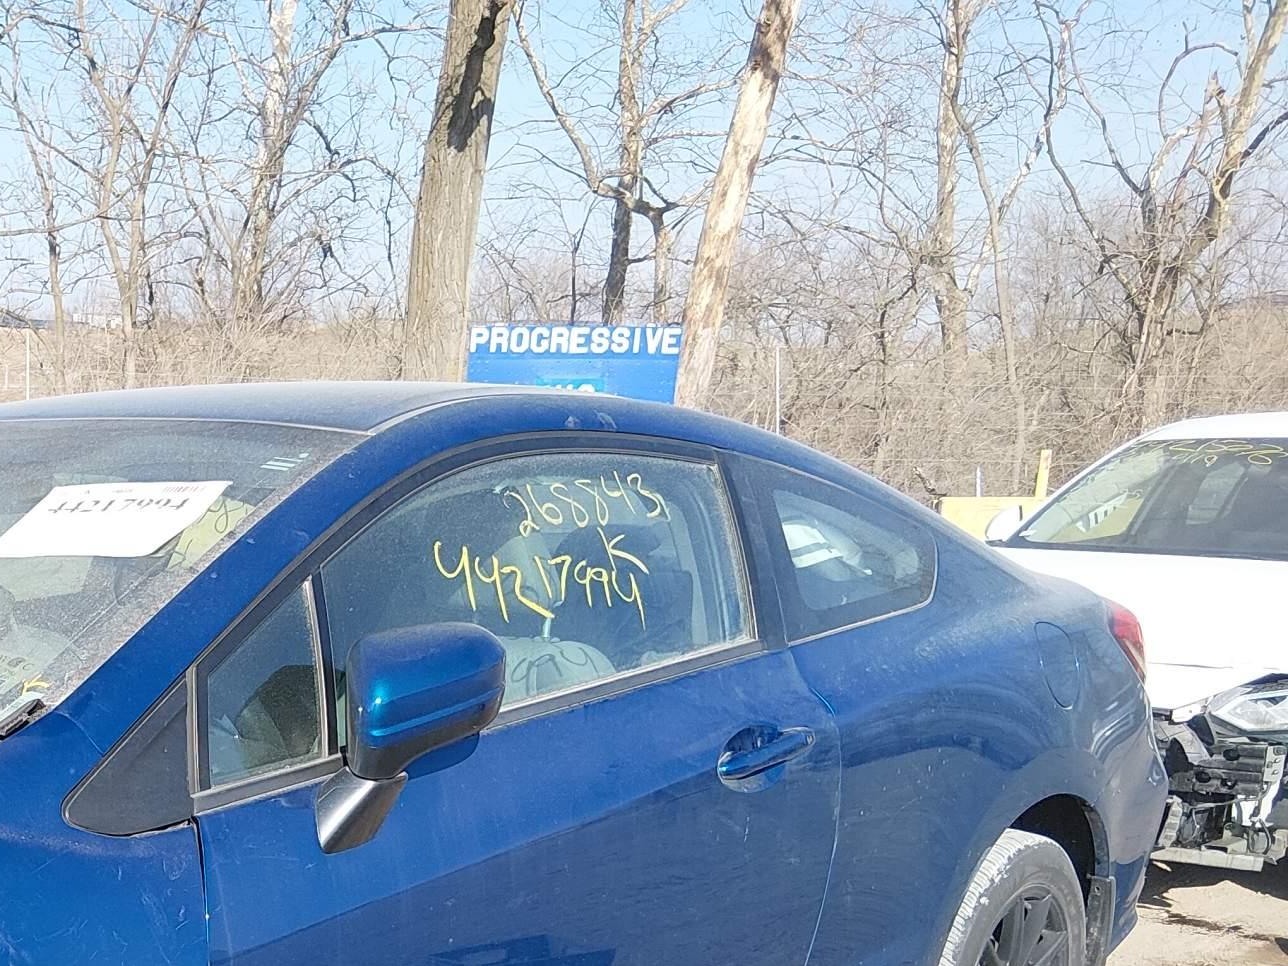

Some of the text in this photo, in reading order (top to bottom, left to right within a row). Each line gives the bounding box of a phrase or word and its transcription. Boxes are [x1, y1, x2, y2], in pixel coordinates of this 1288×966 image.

[470, 326, 682, 355] PROGRESSIVE
[503, 471, 671, 537] 268843
[434, 541, 646, 631] 44217994
